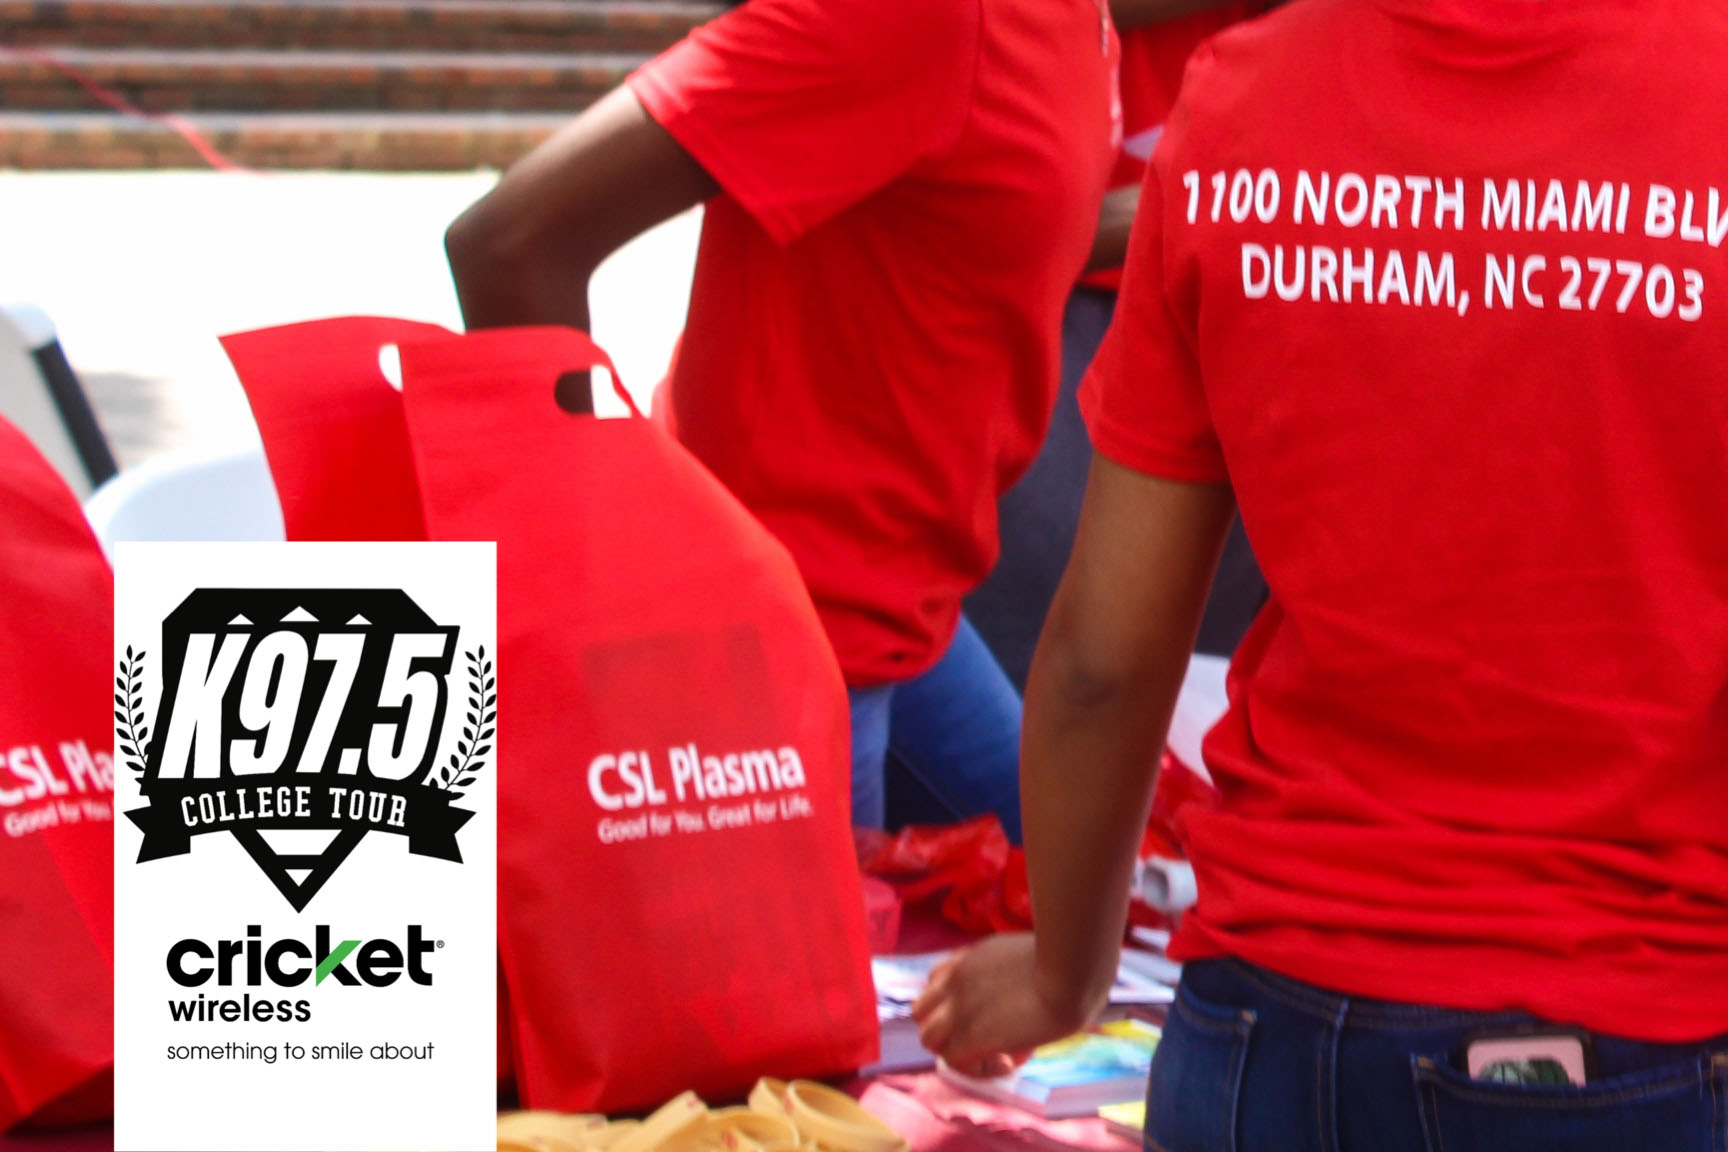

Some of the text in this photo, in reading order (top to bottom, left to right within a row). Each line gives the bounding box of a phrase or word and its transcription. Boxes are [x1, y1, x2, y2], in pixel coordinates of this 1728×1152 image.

[1182, 167, 1280, 226] 1100
[1292, 170, 1466, 231] NORTH
[1481, 177, 1631, 235] MIAMI
[1240, 242, 1706, 322] DURHAM, NC 27703
[587, 742, 807, 811] CSL Plasma
[597, 814, 648, 845] Good
[650, 811, 672, 836] for
[707, 803, 751, 830] Great
[752, 799, 776, 823] for
